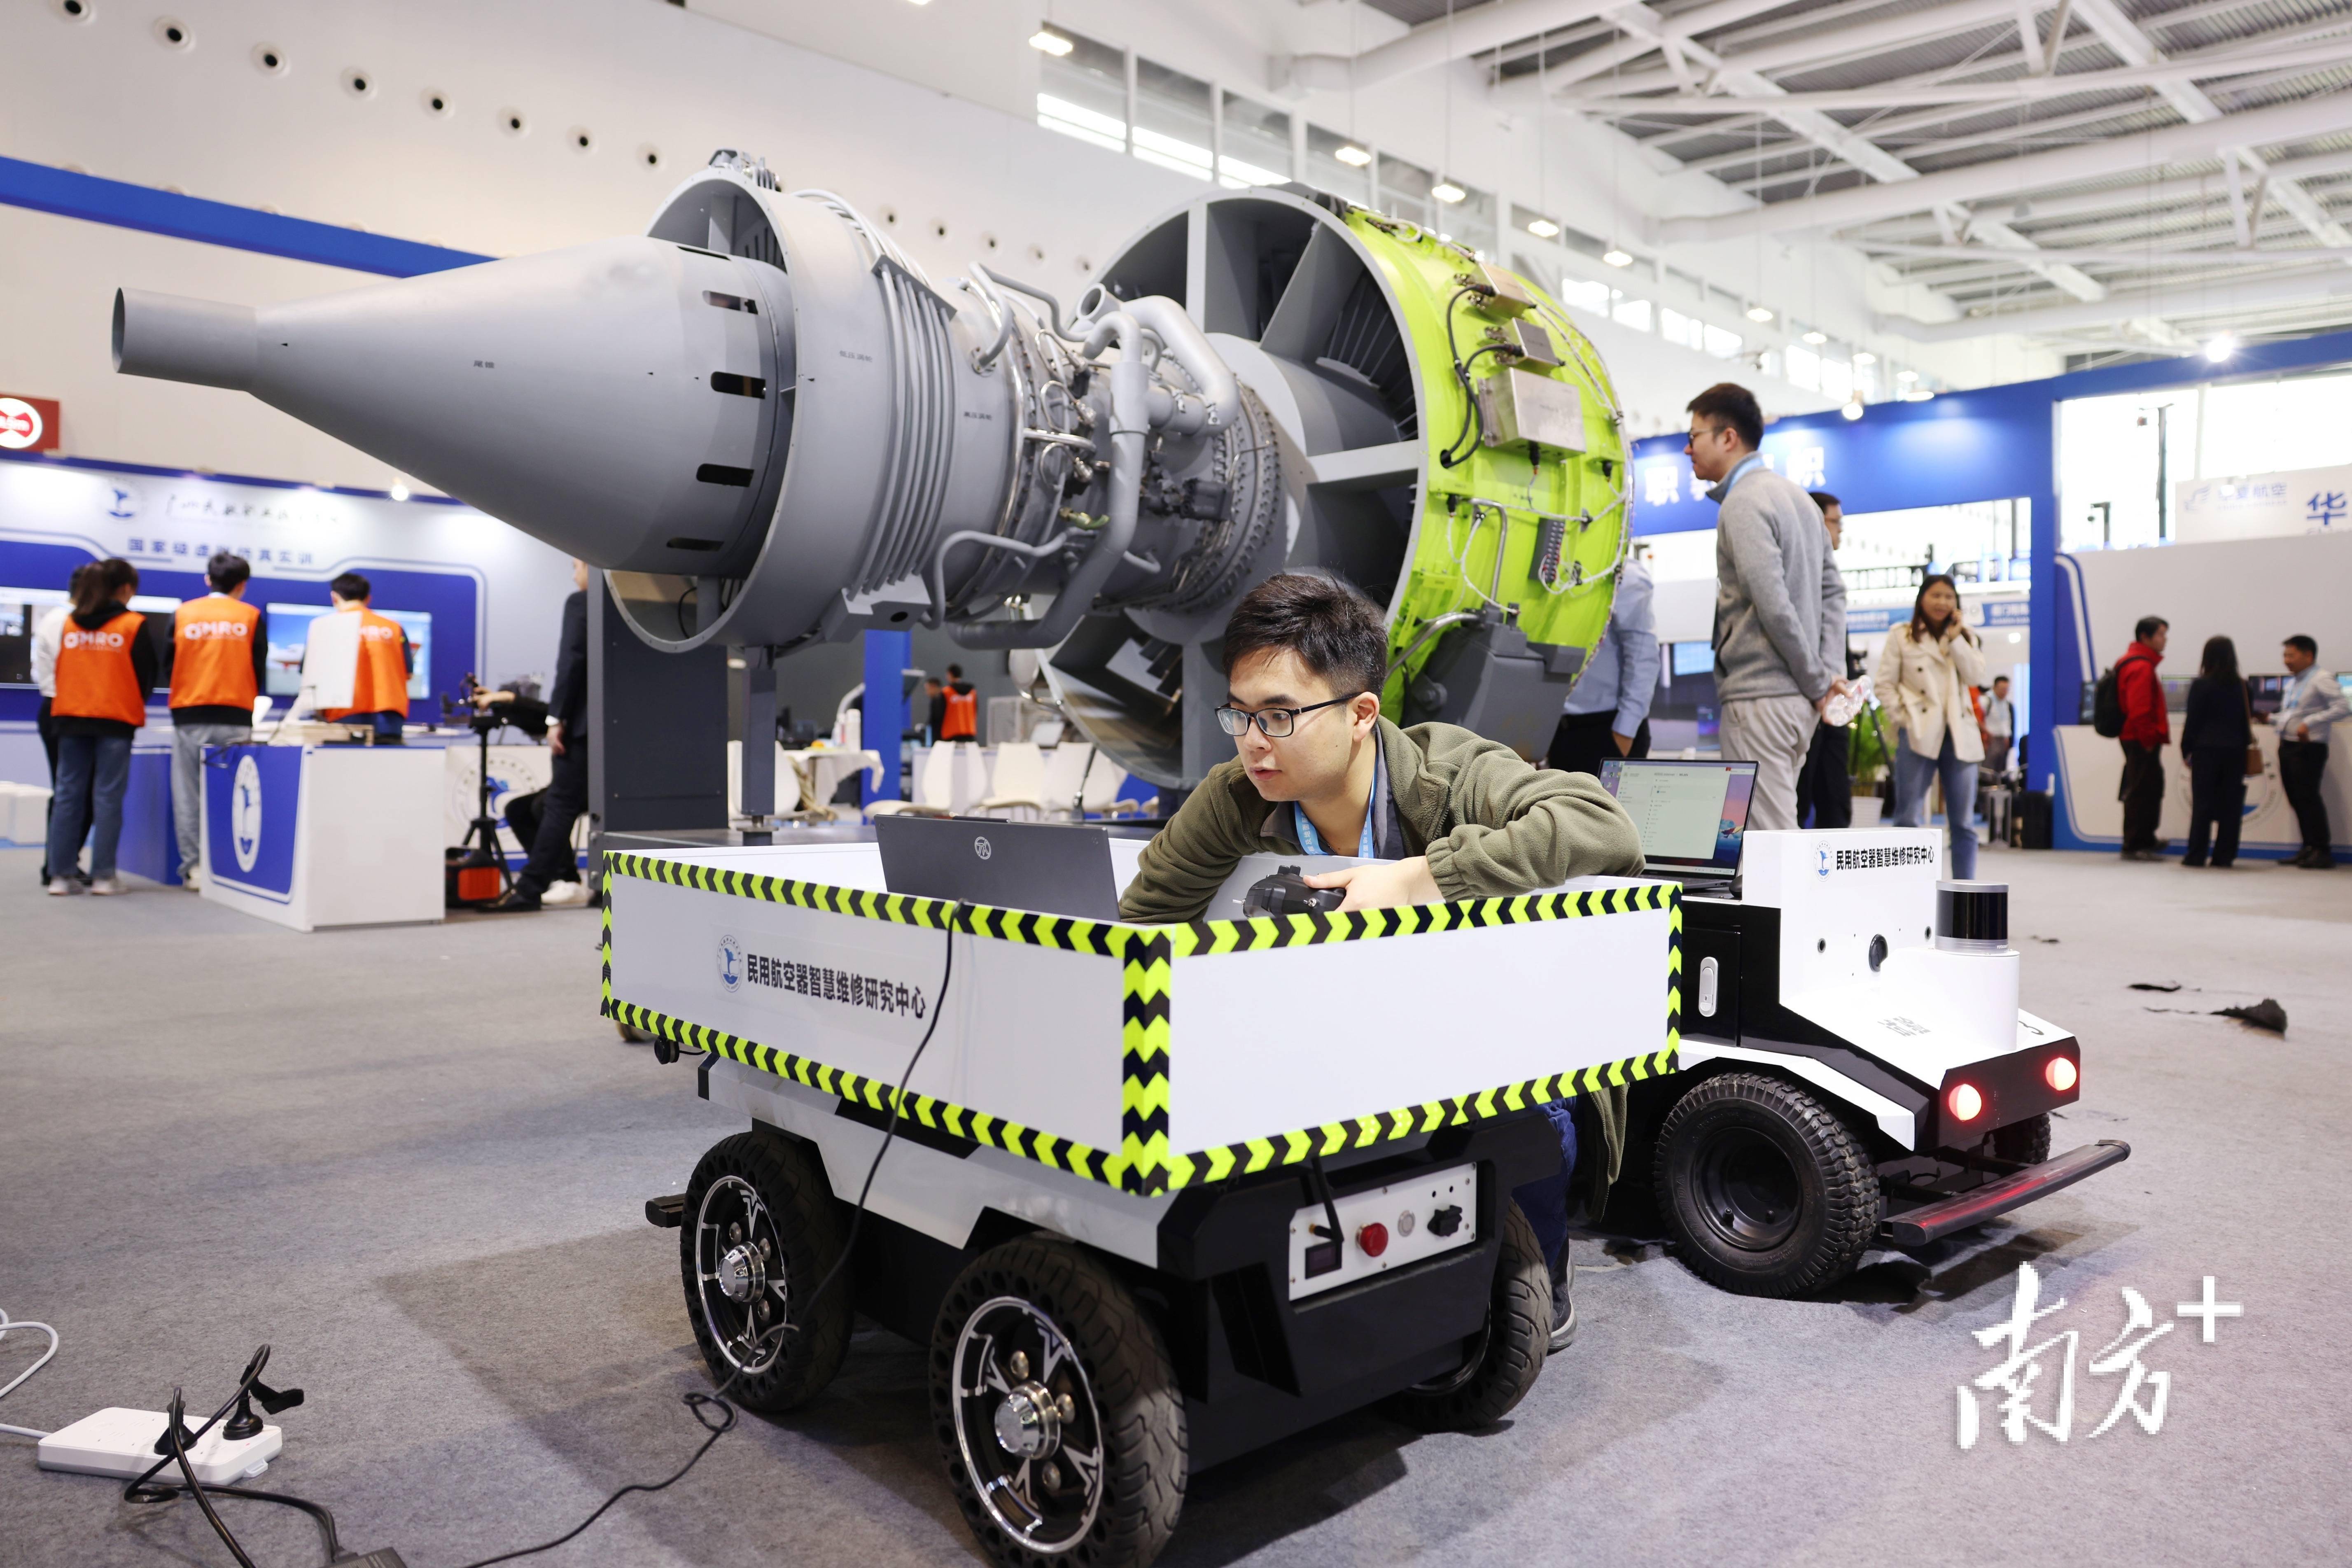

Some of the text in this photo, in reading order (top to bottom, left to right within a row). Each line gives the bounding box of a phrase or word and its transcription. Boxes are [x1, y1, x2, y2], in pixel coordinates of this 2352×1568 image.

[2307, 491, 2347, 525] 华
[1836, 845, 1934, 870] 民用航空器智慧维修研究中心
[747, 954, 926, 1019] 民用航空器智慧维修研究中心
